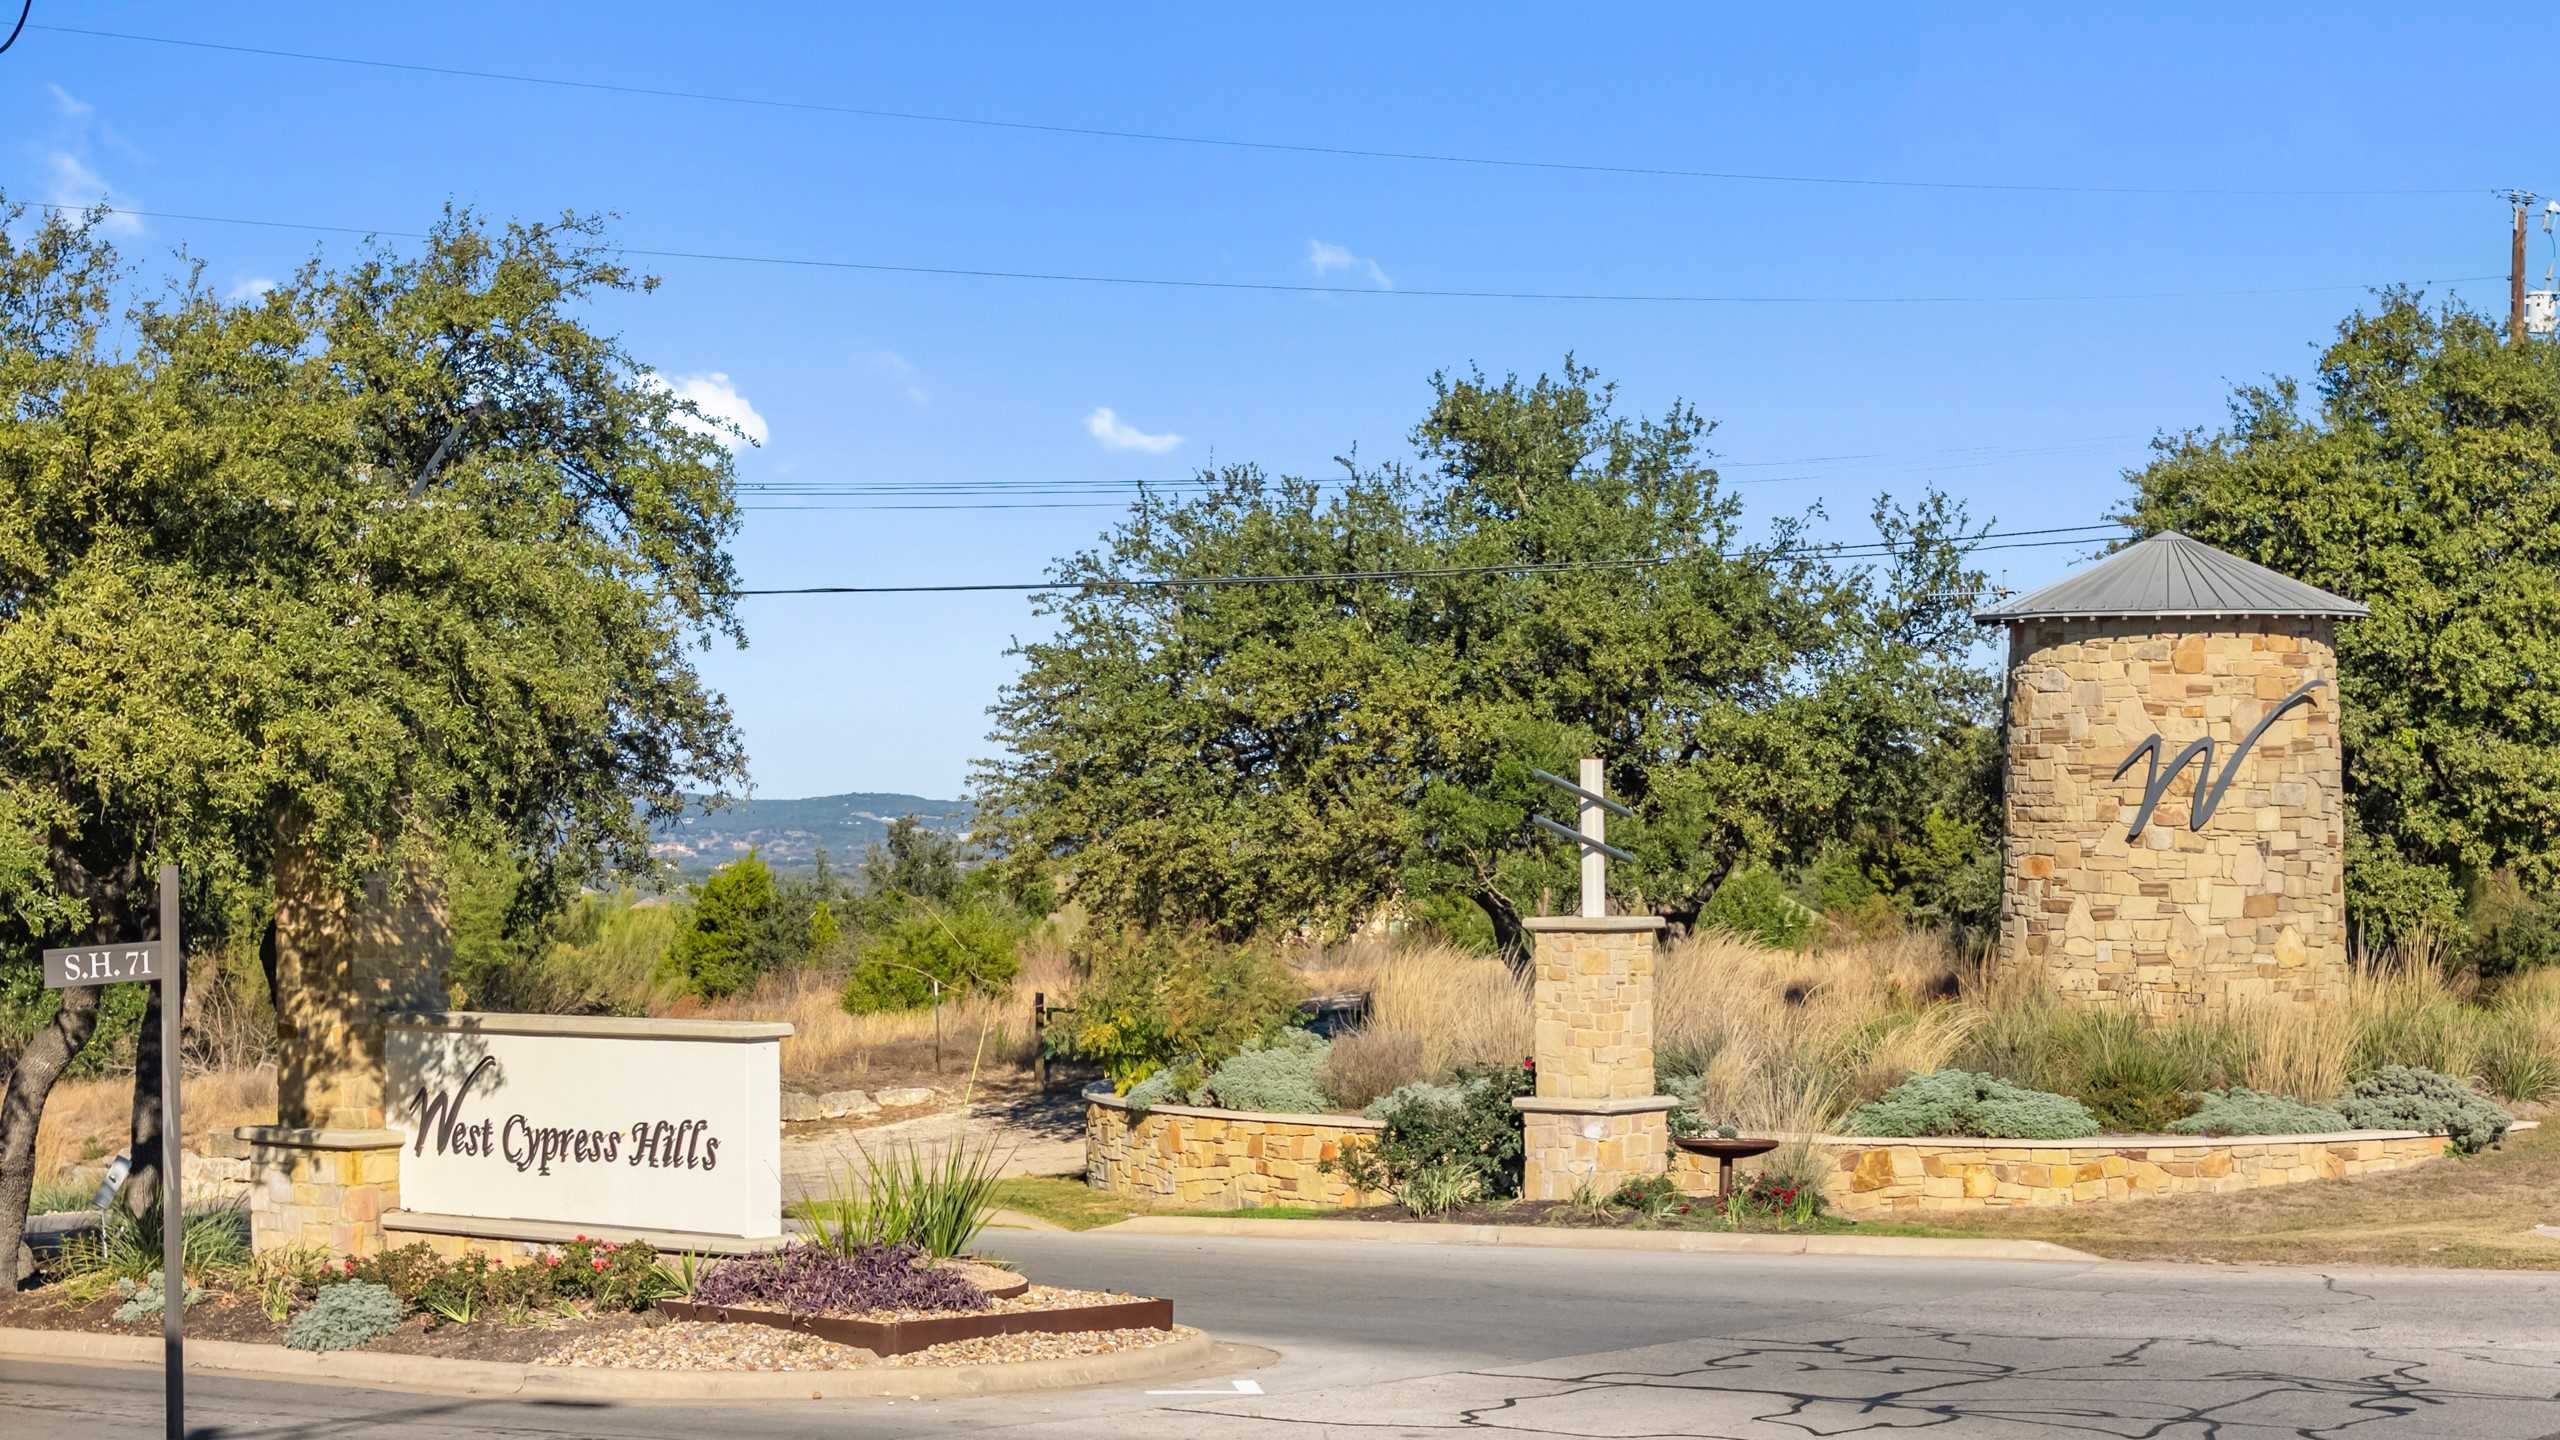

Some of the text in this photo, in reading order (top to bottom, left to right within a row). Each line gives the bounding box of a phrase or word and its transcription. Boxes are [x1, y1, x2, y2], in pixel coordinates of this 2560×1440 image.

[64, 949, 152, 981] S.H. 71
[409, 1055, 720, 1176] West Cypress Hills
